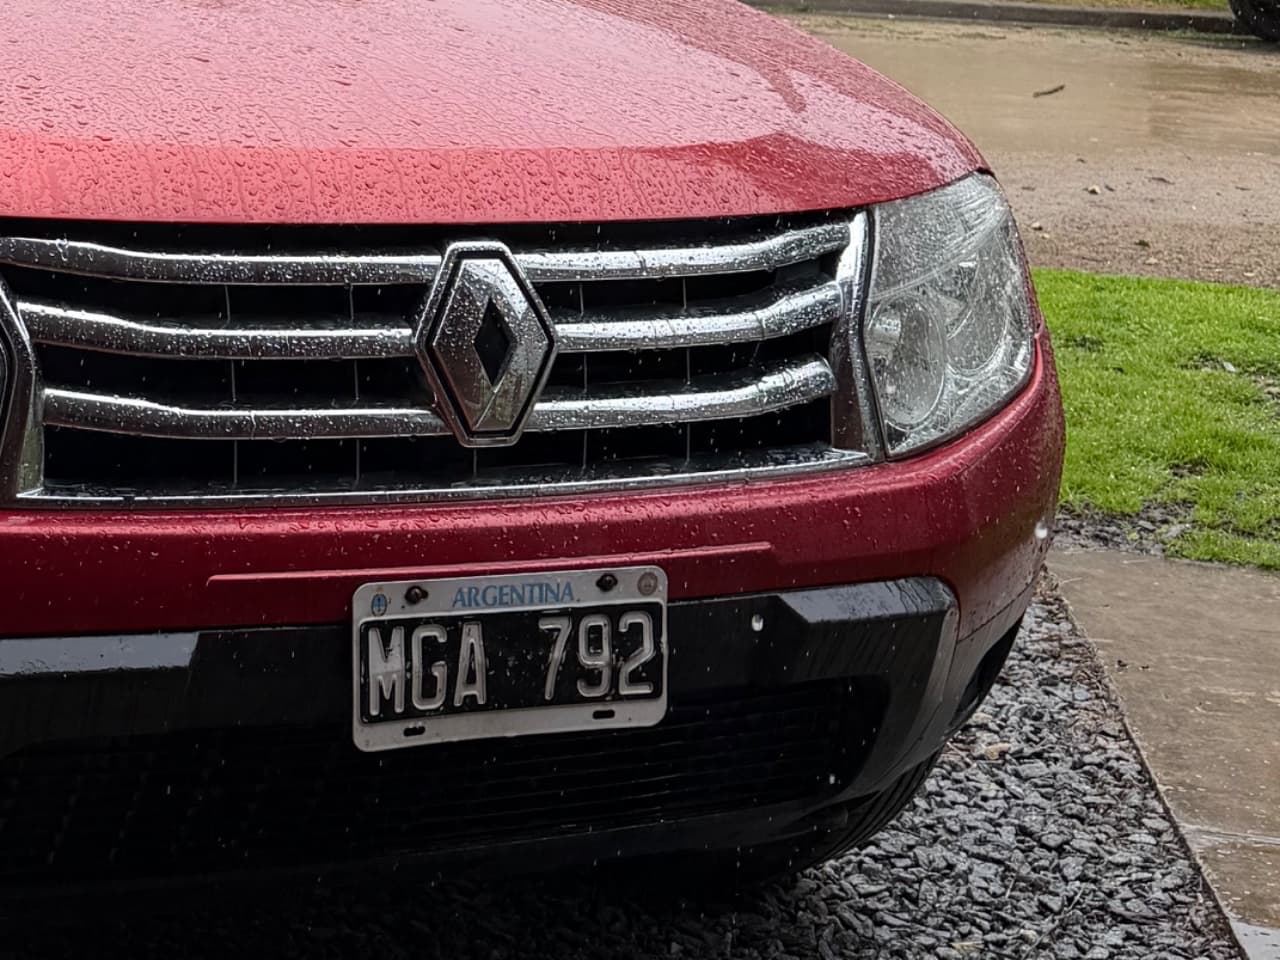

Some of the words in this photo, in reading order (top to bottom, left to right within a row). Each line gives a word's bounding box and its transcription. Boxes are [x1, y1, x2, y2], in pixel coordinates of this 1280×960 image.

[452, 583, 574, 607] ARGENTINA
[369, 620, 487, 716] MGA
[538, 611, 654, 701] 792
